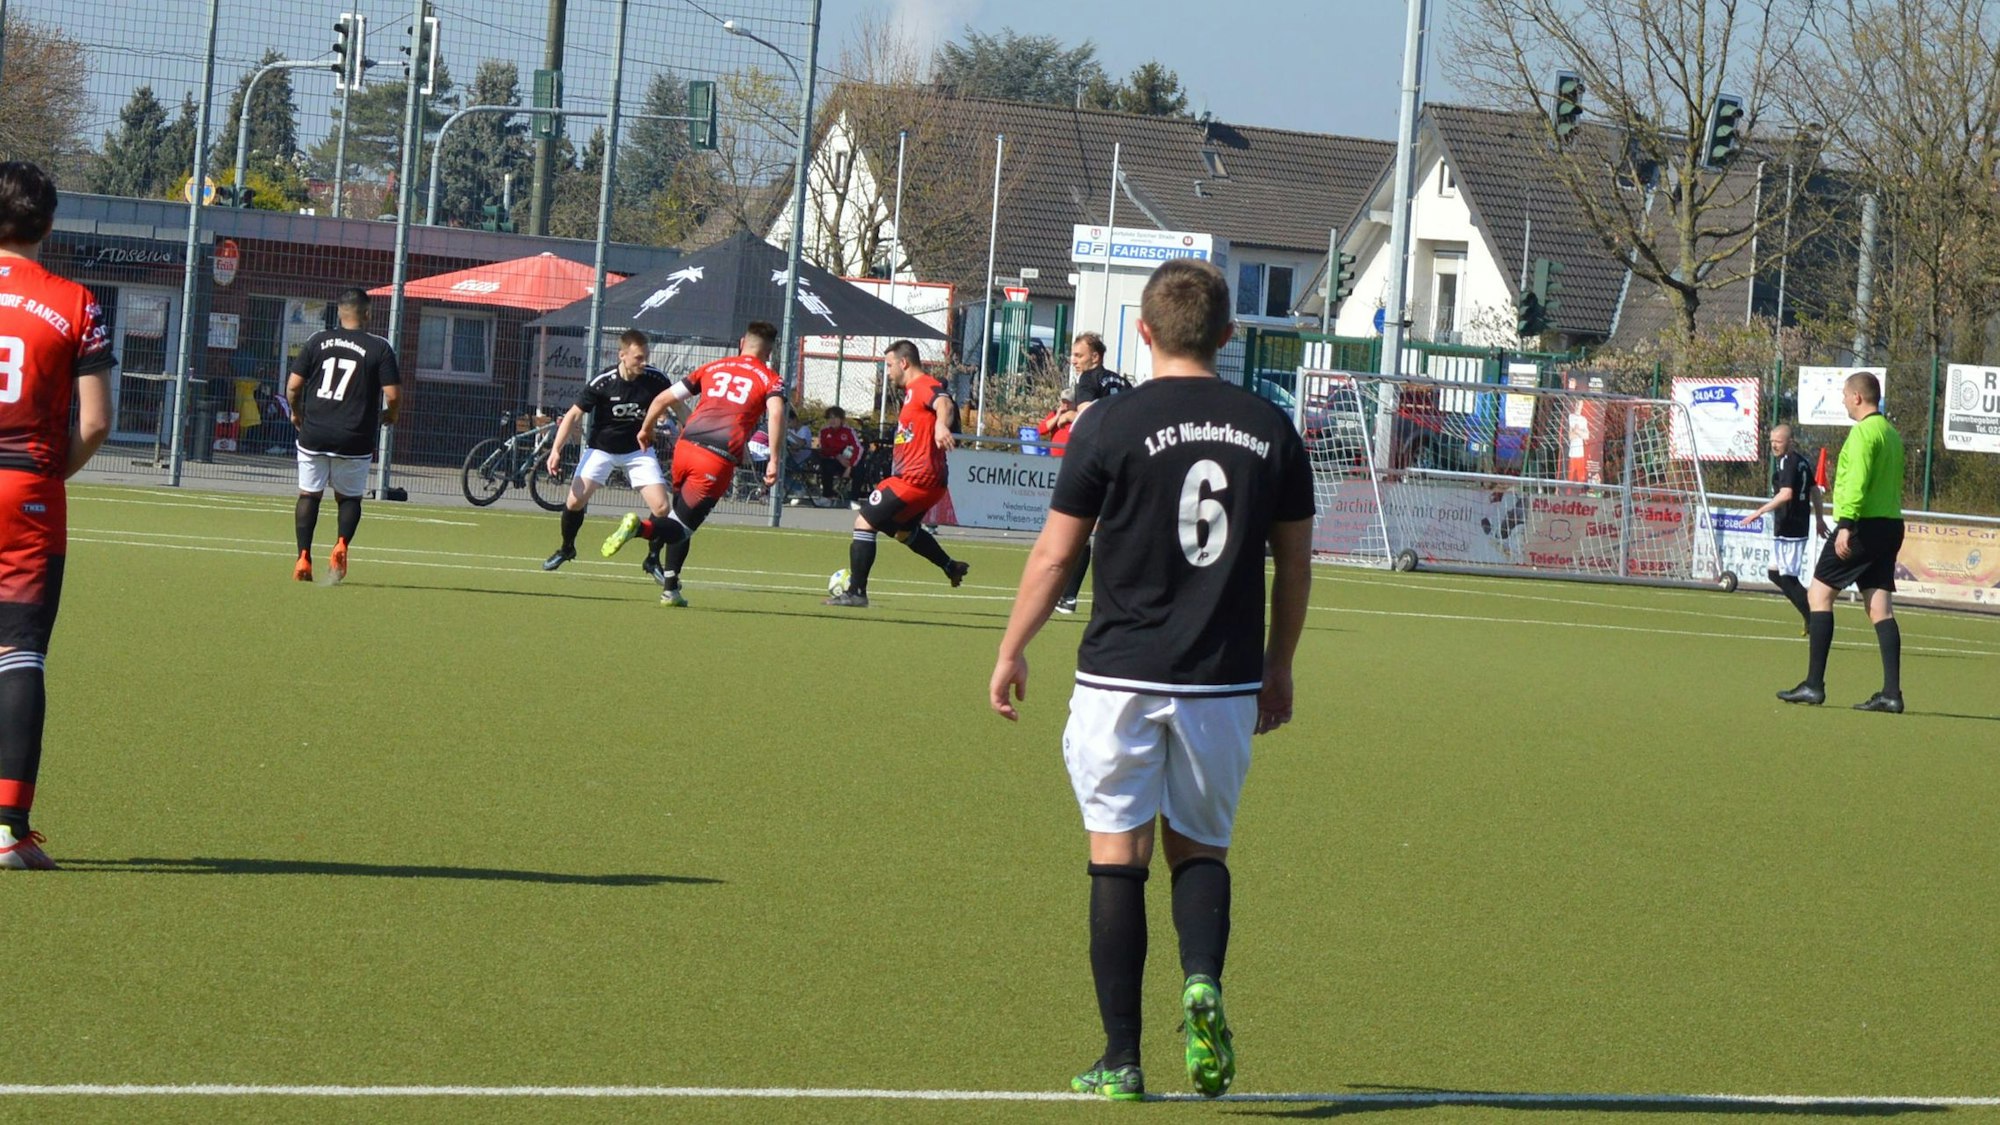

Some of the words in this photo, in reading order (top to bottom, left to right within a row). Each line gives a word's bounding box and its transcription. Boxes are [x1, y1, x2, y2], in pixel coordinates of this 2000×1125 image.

[0, 292, 71, 337] ORF-RANZEL
[316, 357, 357, 401] 17
[707, 371, 753, 405] 33
[1144, 426, 1178, 457] 1.FC
[1178, 421, 1270, 459] Niederkassel
[1002, 502, 1043, 512] Niederkassel
[1178, 459, 1229, 567] 6
